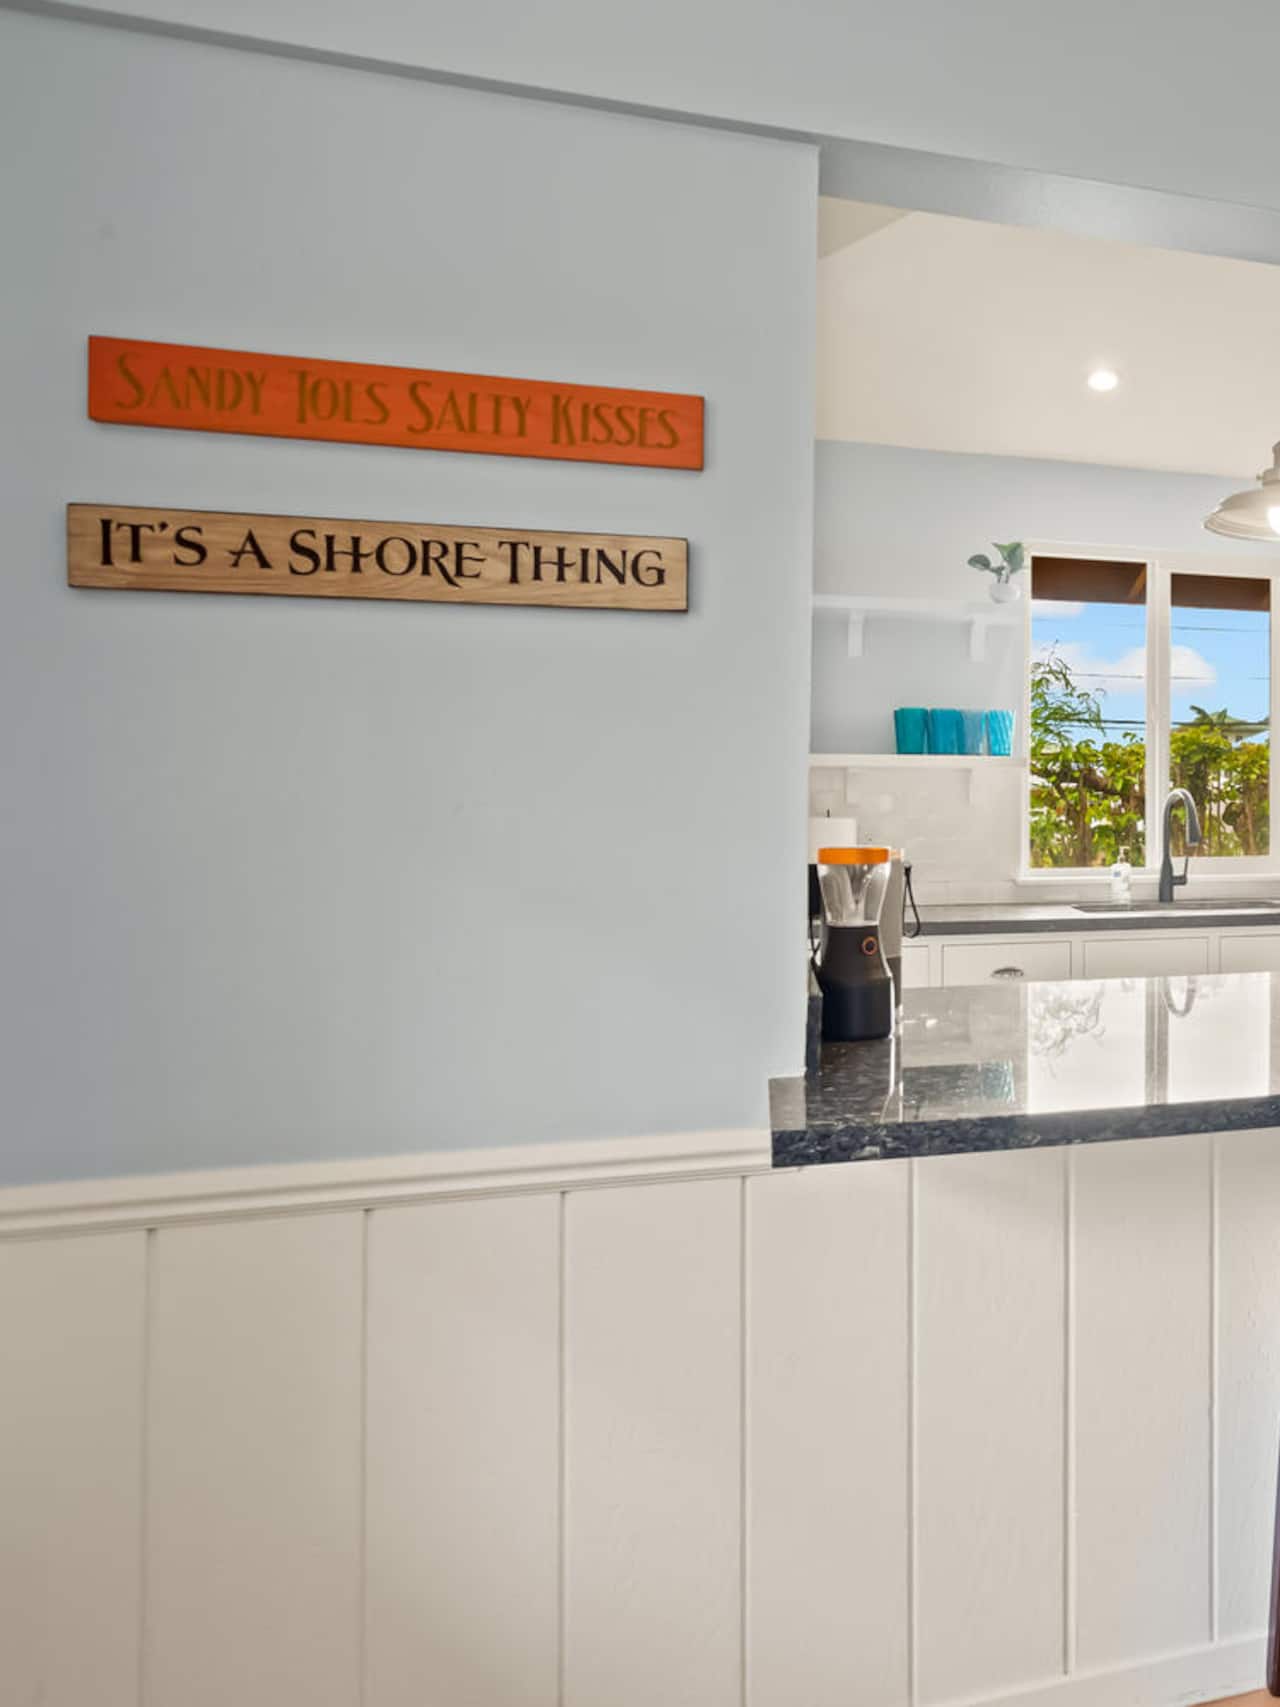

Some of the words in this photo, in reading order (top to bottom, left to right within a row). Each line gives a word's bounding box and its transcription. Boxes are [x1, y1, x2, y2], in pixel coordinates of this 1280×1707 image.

[115, 350, 268, 416] SANDY
[405, 379, 532, 438] SALTY
[549, 393, 681, 450] KISSES
[99, 518, 208, 567] IT'S
[229, 528, 272, 570] A
[287, 529, 488, 588] SHORE
[498, 540, 667, 588] THING
